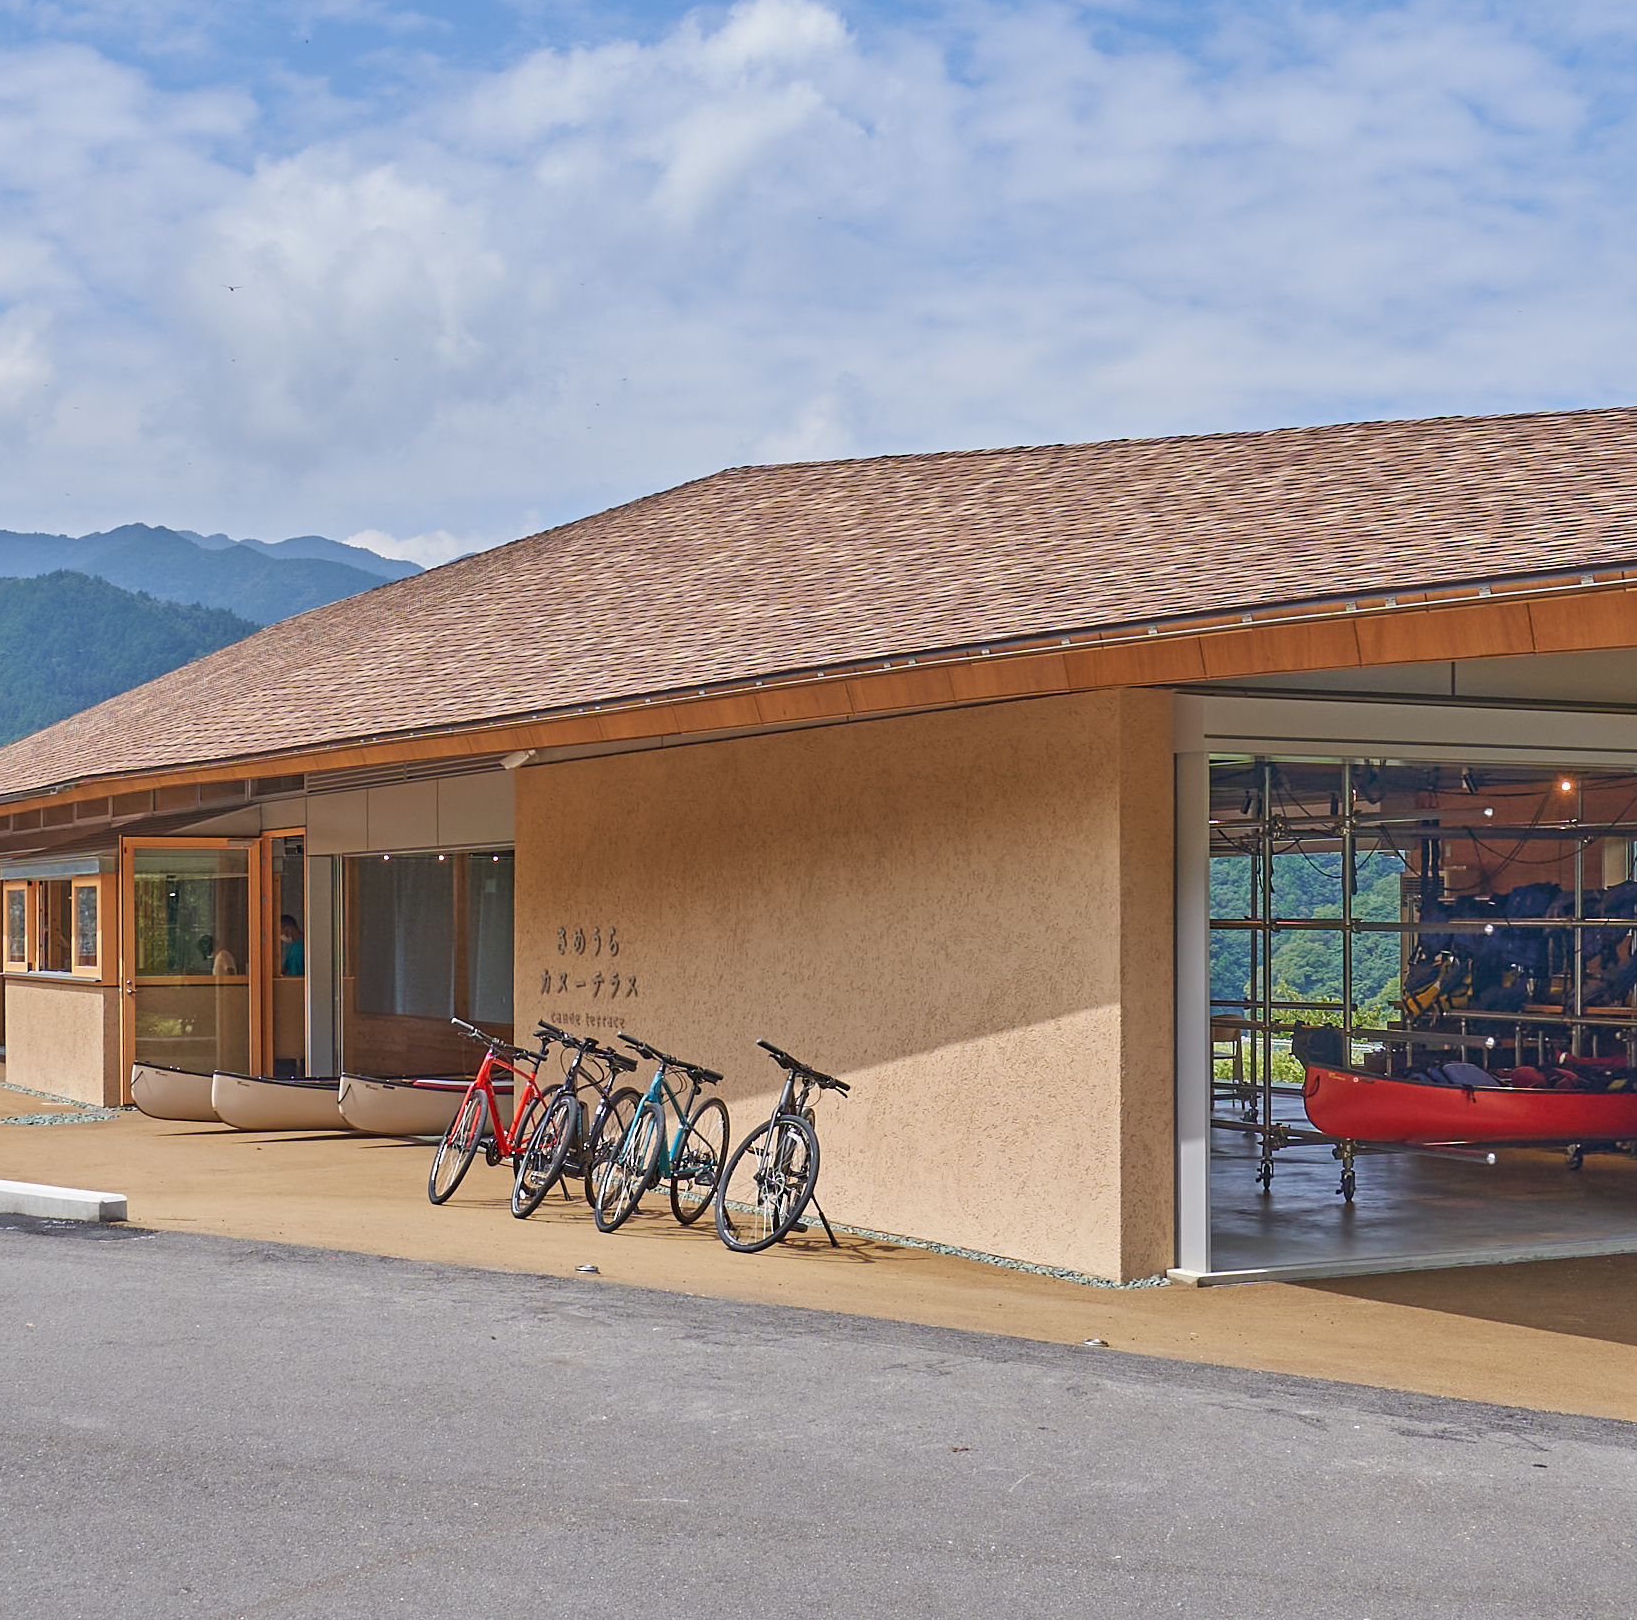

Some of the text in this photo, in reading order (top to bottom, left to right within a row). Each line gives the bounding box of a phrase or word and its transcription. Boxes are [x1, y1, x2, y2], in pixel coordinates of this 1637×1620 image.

[540, 968, 638, 999] カヌーテラス
[551, 1012, 625, 1029] canoe terrace
